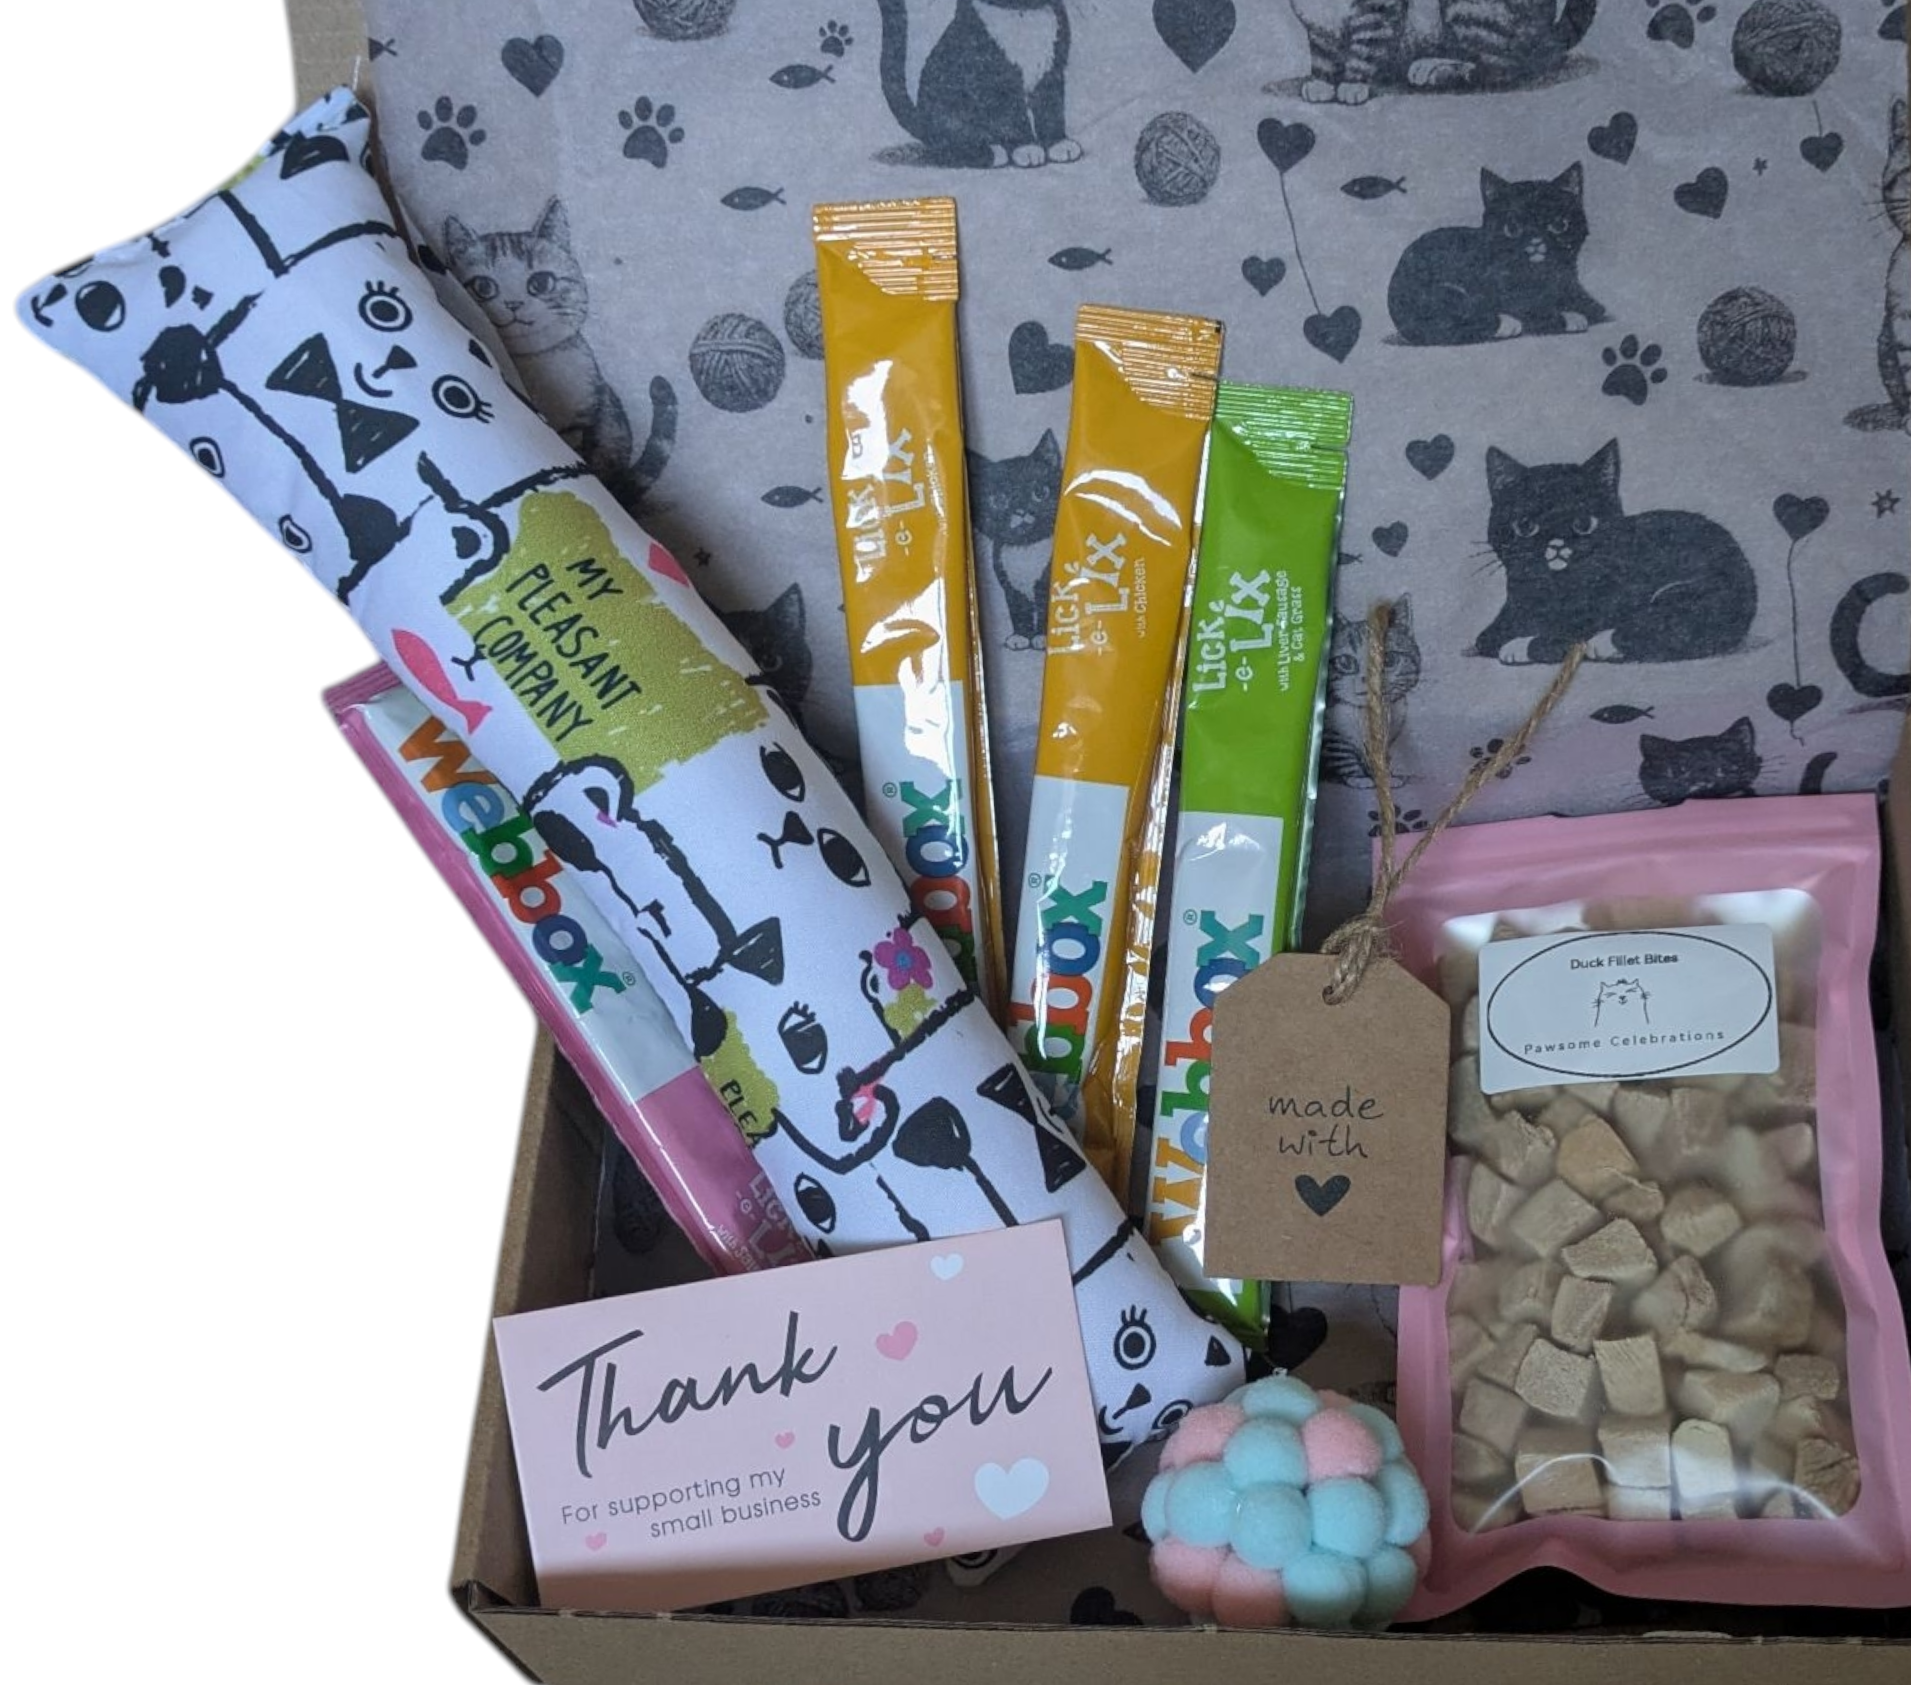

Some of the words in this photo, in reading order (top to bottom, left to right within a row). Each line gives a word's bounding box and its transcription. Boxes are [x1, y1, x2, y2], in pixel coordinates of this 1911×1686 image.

[565, 557, 624, 601] MY
[1133, 557, 1148, 614] Chicken
[1223, 569, 1274, 653] Lix
[505, 563, 643, 710] PLEASANT
[1276, 631, 1291, 665] Liver
[1293, 652, 1305, 662] &
[472, 616, 594, 742] COMPANY
[1277, 664, 1291, 692] with
[398, 715, 626, 1014] Webbox
[1570, 957, 1604, 970] Duck
[1608, 955, 1641, 967] Fillet
[1644, 953, 1678, 965] Bites
[1524, 1038, 1601, 1055] Pawsome
[1610, 1029, 1725, 1047] Celebrations
[1268, 1084, 1384, 1120] made
[1279, 1124, 1368, 1159] with
[536, 1311, 837, 1478] Thank
[827, 1365, 1053, 1542] you
[561, 1502, 599, 1525] For
[608, 1478, 741, 1520] supporting
[749, 1467, 787, 1490] my
[650, 1508, 713, 1539] small
[721, 1489, 822, 1525] business
